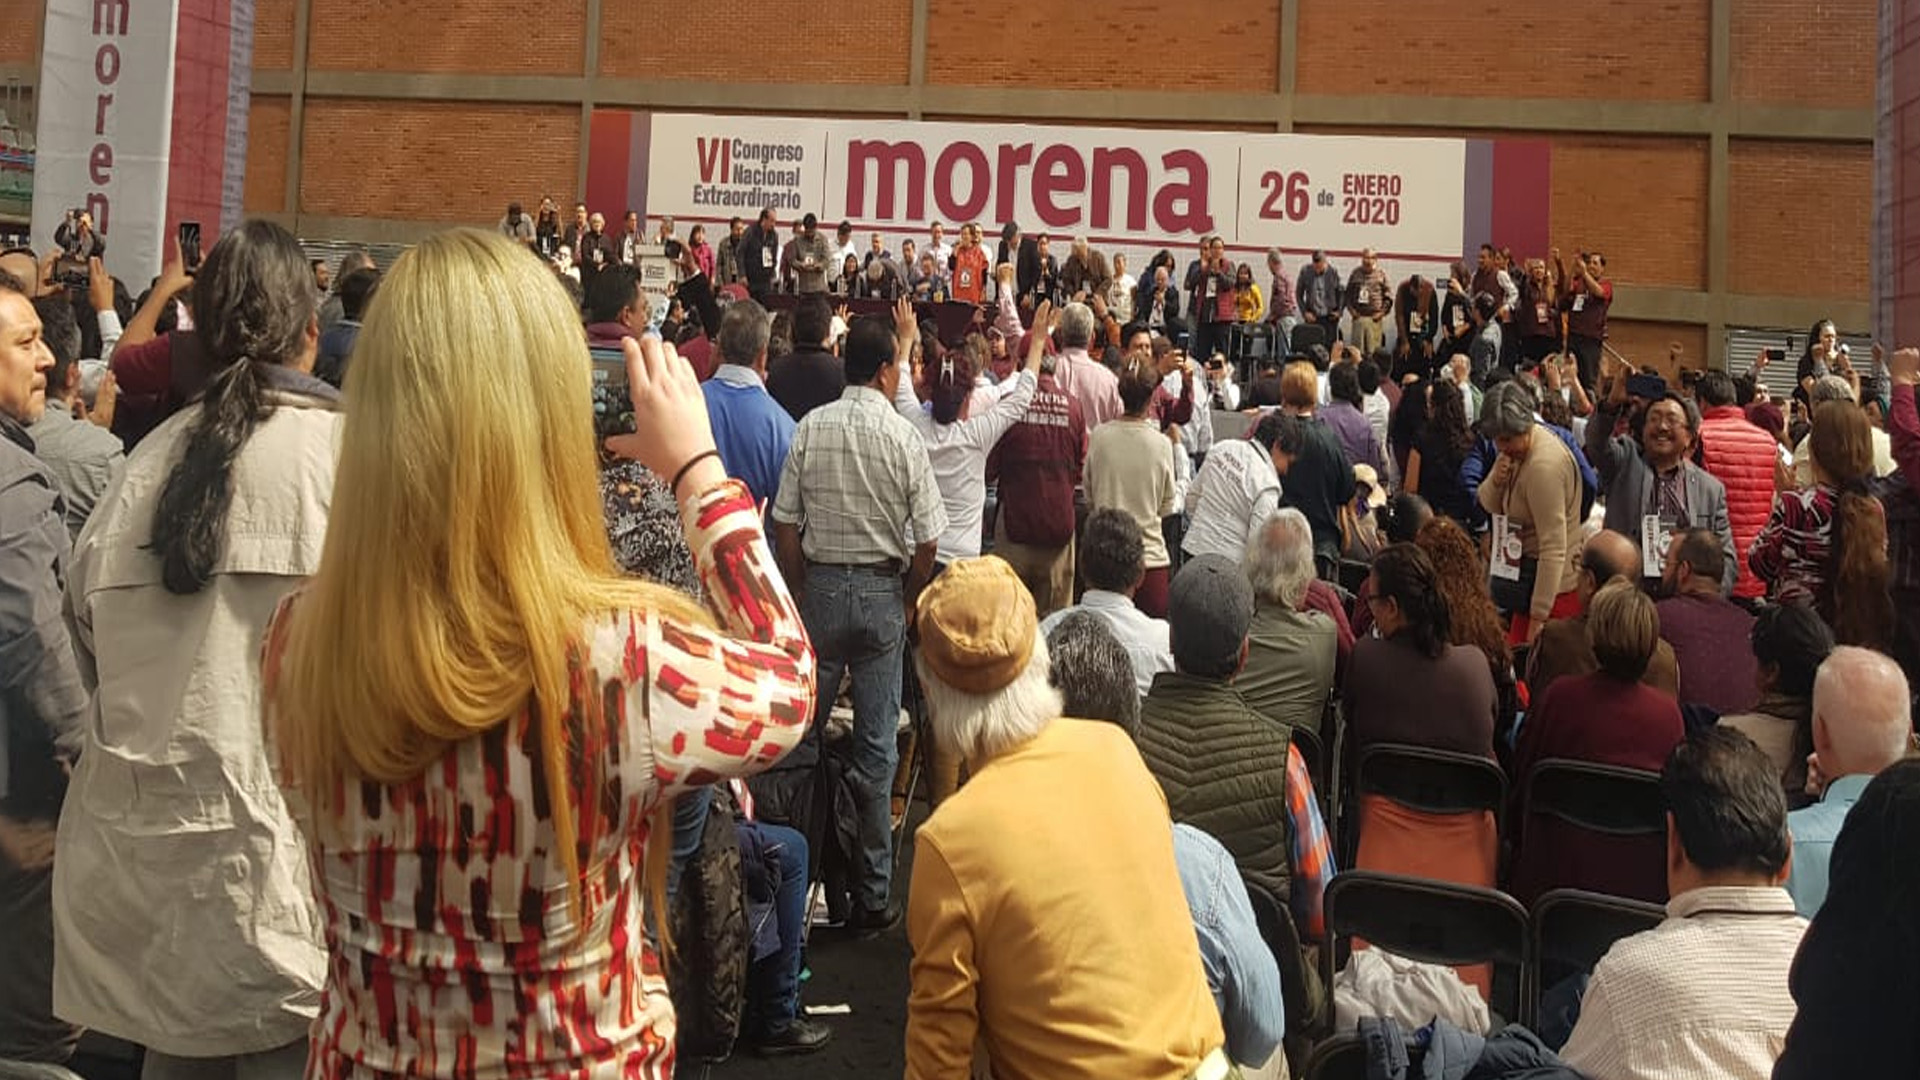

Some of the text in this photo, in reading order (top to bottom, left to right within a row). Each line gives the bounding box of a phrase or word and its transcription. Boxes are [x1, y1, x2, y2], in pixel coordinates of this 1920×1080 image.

[86, 0, 130, 258] moren
[697, 137, 731, 184] VI
[732, 138, 804, 164] Congreso
[732, 163, 801, 187] Nacional
[847, 139, 1214, 233] morena
[1342, 173, 1402, 197] ENERO
[693, 184, 802, 210] Extraordinario
[1259, 171, 1335, 222] 26 de
[1342, 196, 1400, 226] 2020
[1030, 391, 1069, 406] orena
